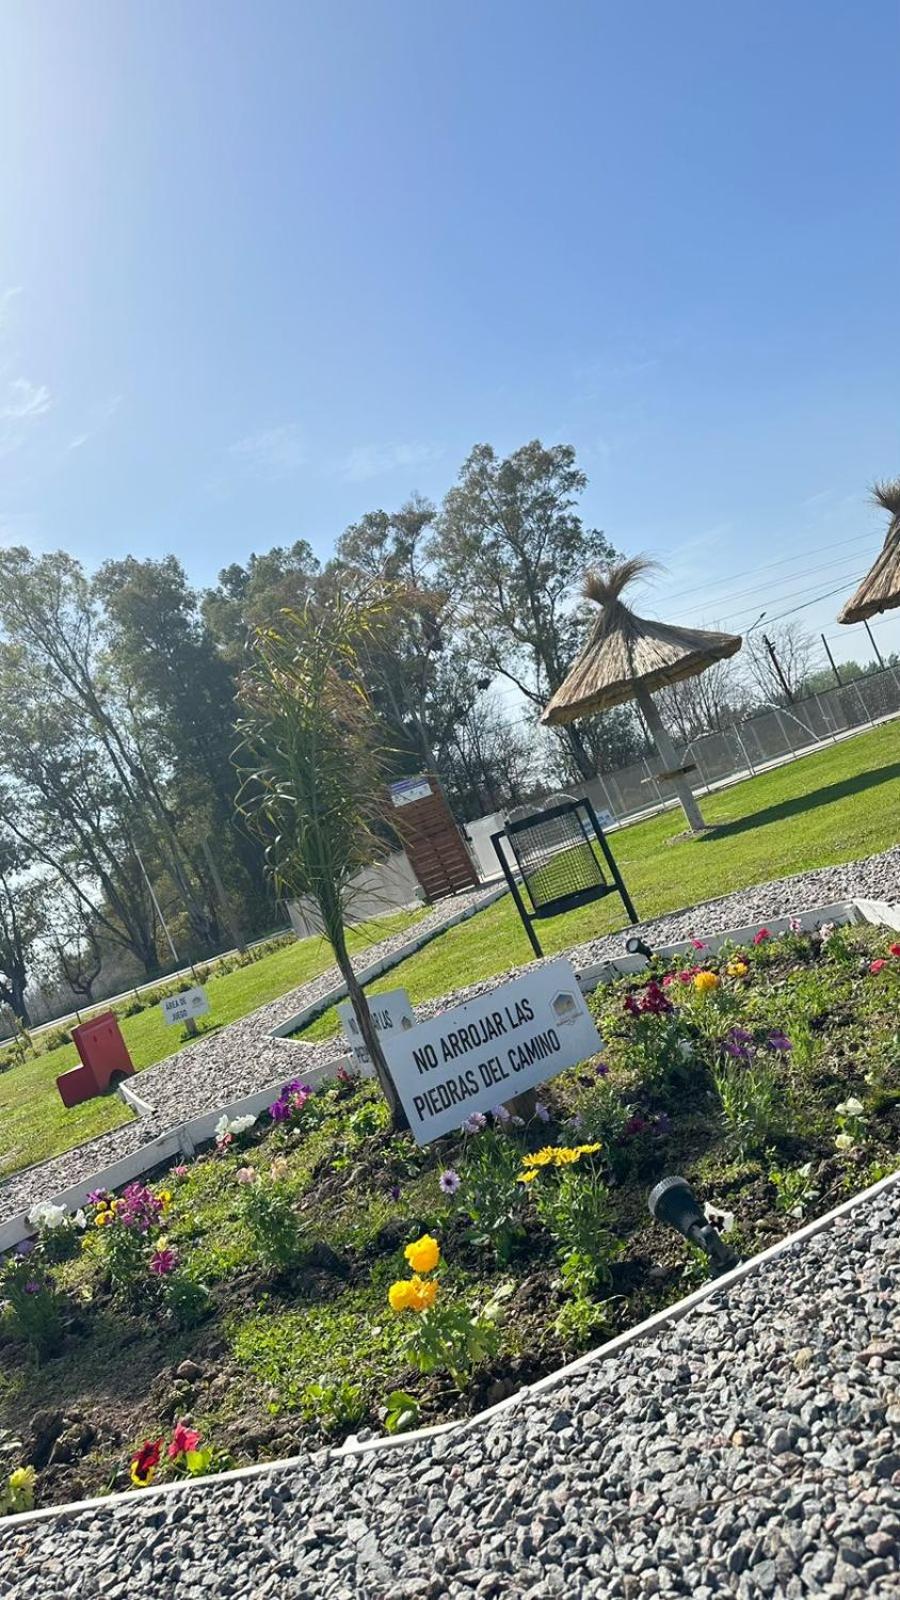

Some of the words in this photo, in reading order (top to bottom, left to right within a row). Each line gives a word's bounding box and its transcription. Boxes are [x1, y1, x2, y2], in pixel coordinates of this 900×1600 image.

[379, 1009, 393, 1030] LAS
[412, 1044, 438, 1075] NO
[440, 1011, 508, 1063] ARROJAR
[504, 998, 535, 1029] LAS
[412, 1069, 480, 1122] PIEDRAS
[478, 1056, 510, 1088] DEL
[507, 1028, 561, 1073] CAMINO
